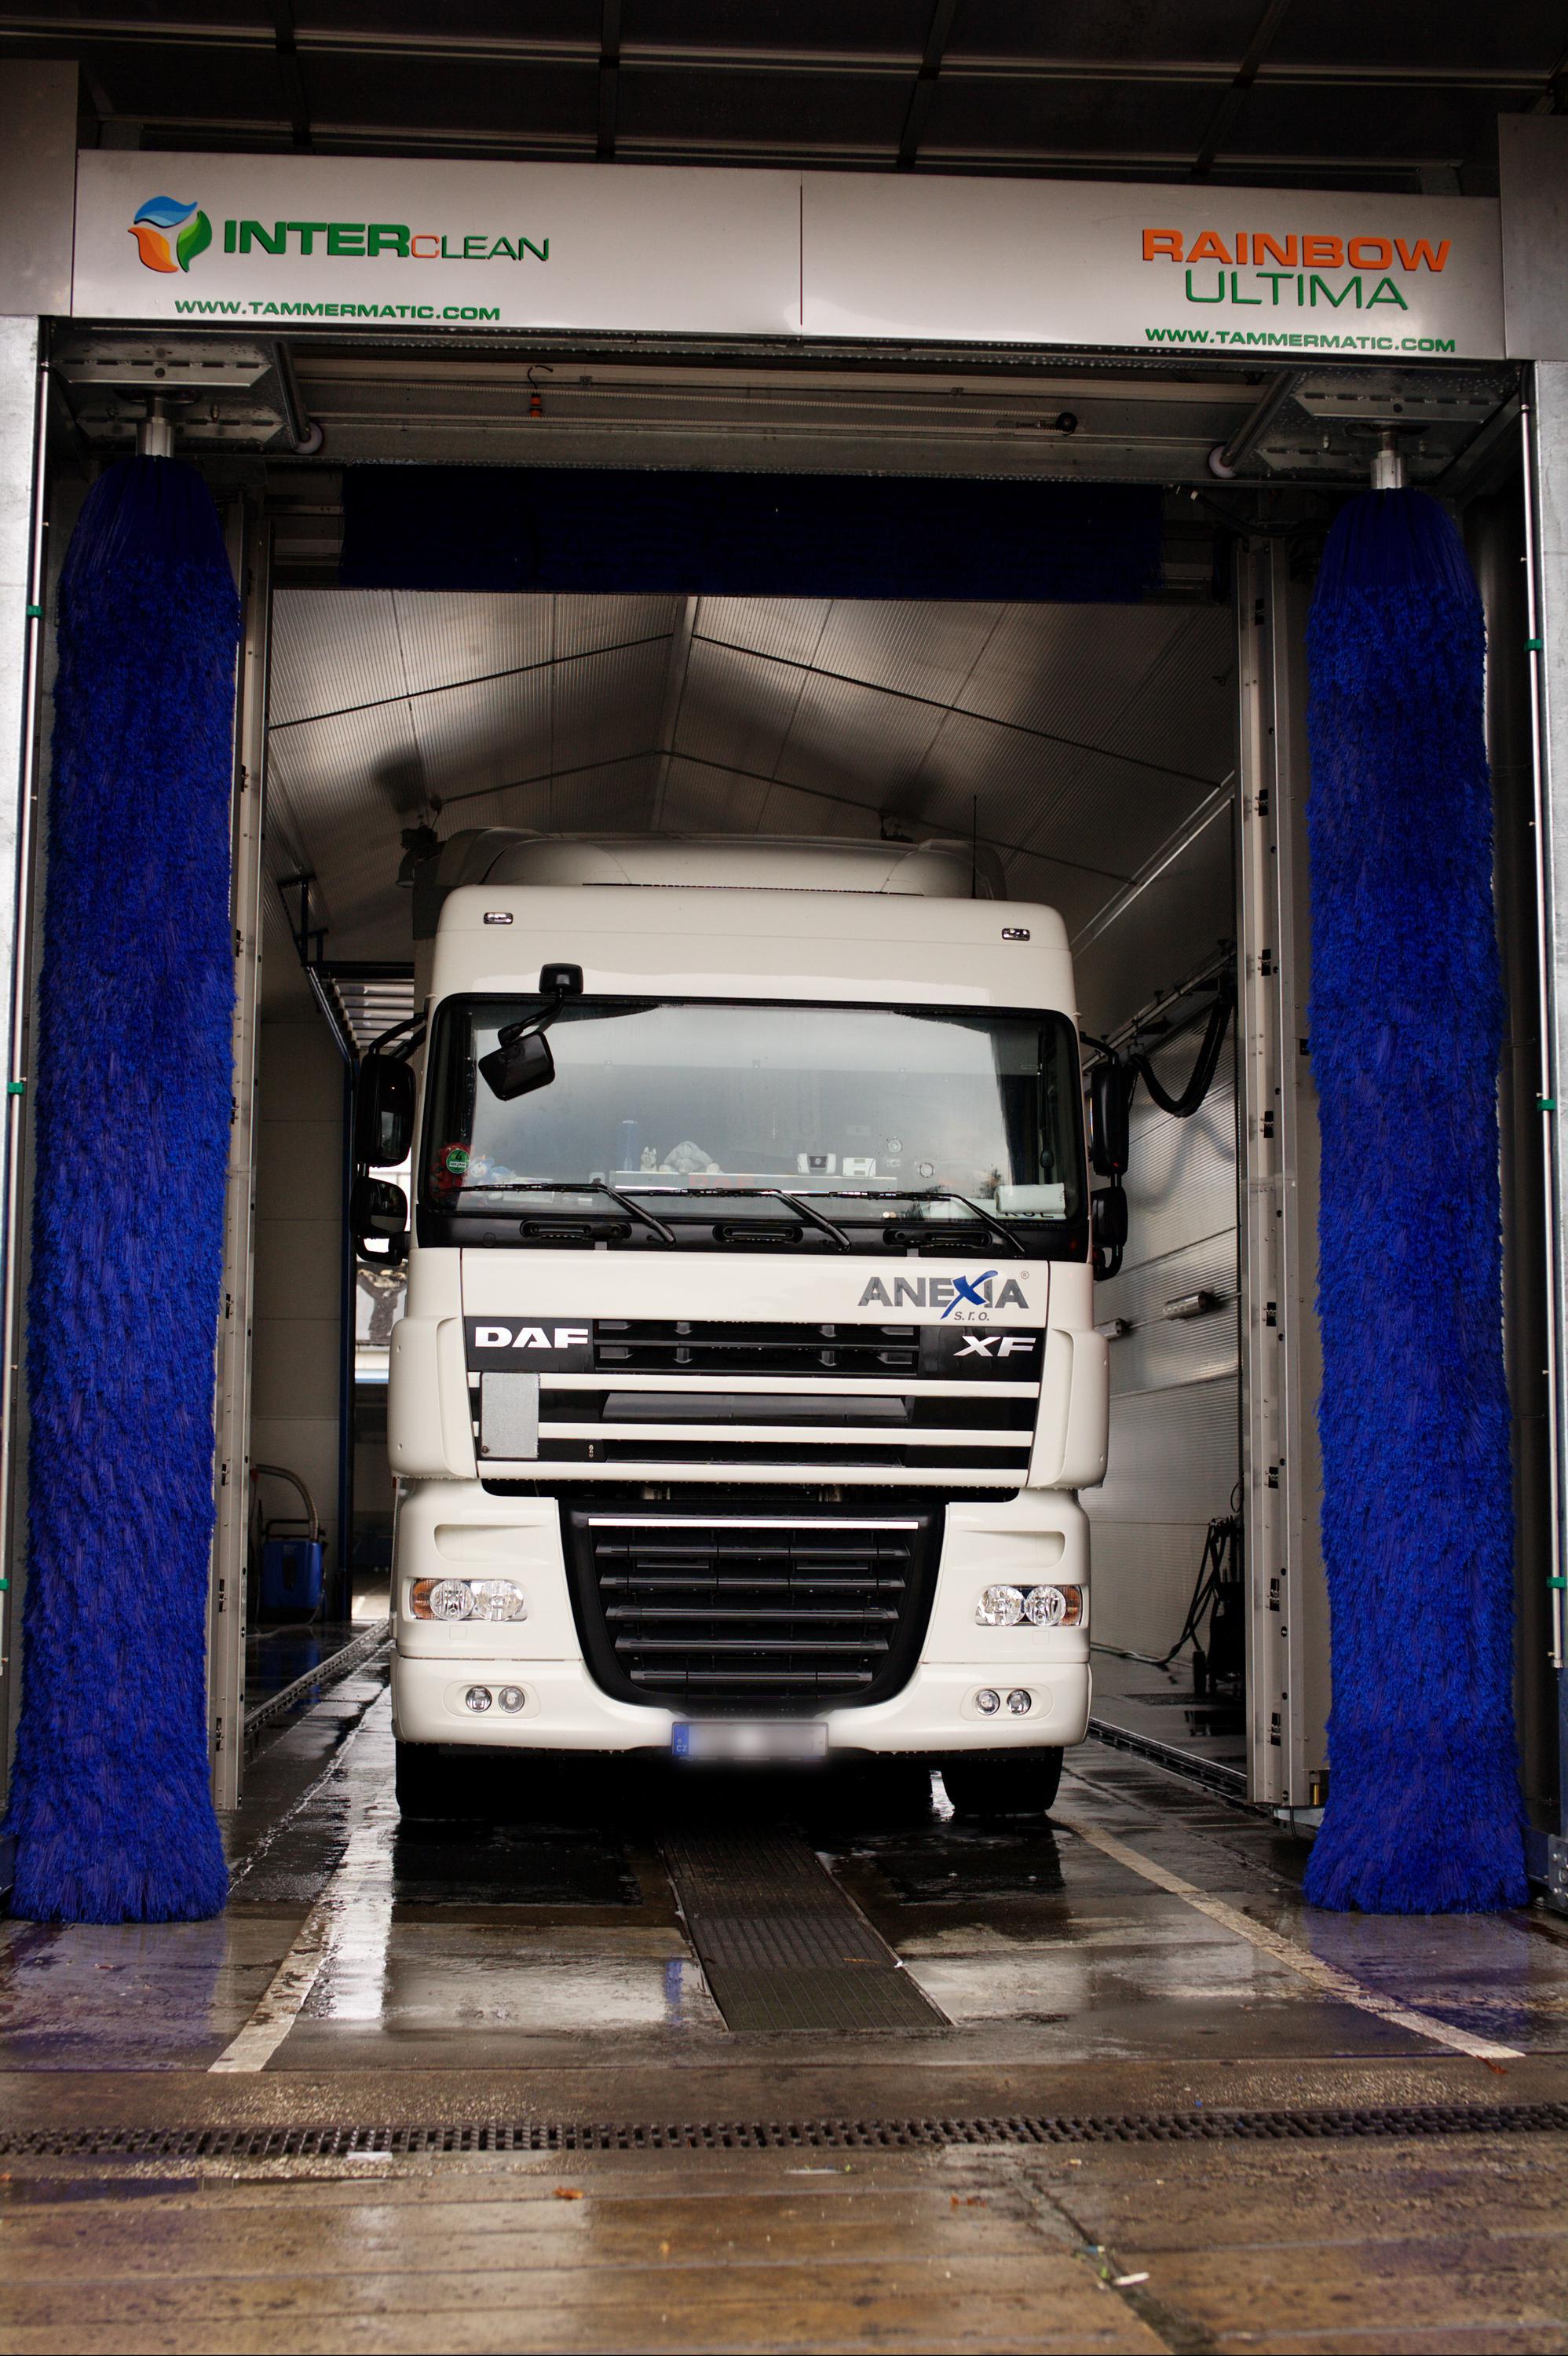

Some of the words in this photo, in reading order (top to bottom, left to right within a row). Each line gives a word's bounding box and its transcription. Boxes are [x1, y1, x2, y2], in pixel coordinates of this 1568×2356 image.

[224, 219, 550, 261] INTERCLEAN
[1142, 229, 1451, 272] RAINBOW
[1186, 269, 1408, 310] ULTIMA
[175, 300, 500, 320] WWW.TAMMERMATIC.COM
[1145, 327, 1456, 353] WWW.TAMMERMATIC.COM
[857, 1270, 1029, 1319] ANEXIA
[474, 1326, 589, 1349] DAF
[953, 1335, 1036, 1357] XF
[676, 1744, 688, 1753] CZ
